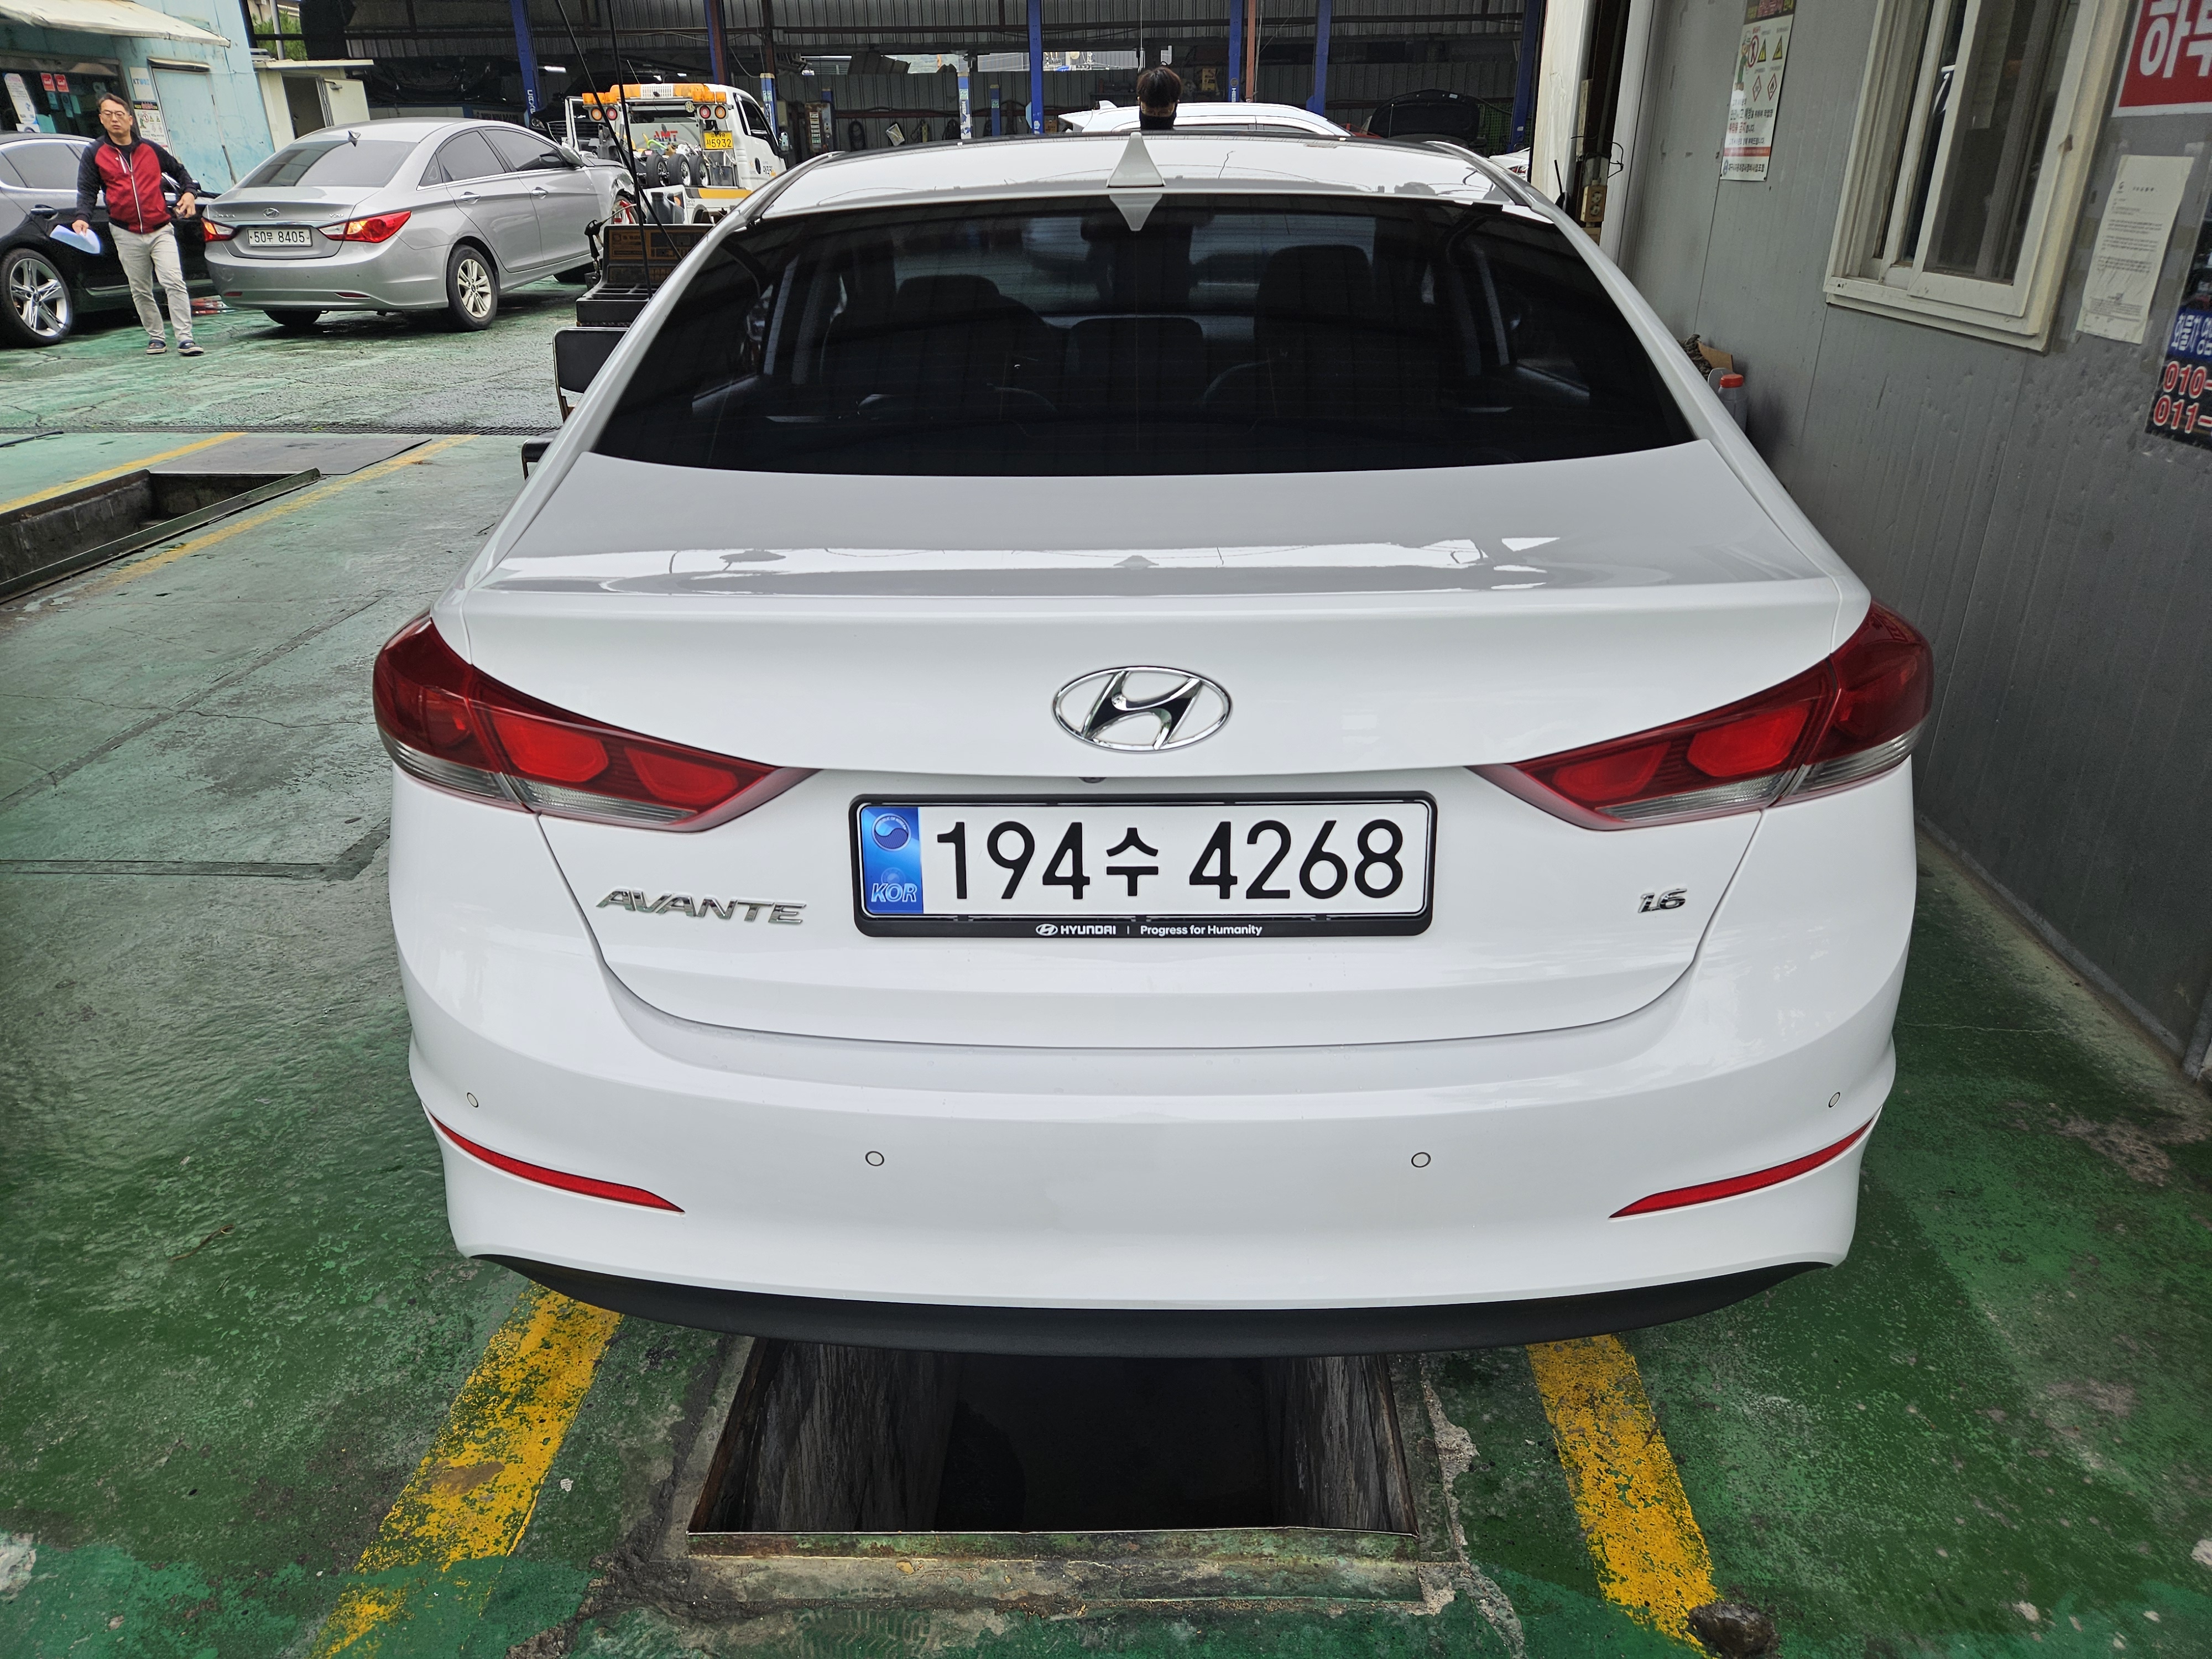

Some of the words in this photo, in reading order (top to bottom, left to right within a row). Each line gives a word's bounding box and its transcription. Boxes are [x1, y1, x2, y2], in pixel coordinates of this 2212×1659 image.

[653, 131, 678, 142] AMT
[254, 231, 273, 243] 50무
[278, 231, 305, 243] 8405
[2171, 313, 2203, 352] 화물차
[937, 820, 1159, 900] 194수
[1189, 819, 1404, 900] 4268
[871, 883, 917, 902] KOR
[596, 888, 807, 924] AVANTE
[1060, 925, 1117, 935] HYUNDAI
[1140, 925, 1188, 937] Progress
[1190, 924, 1206, 935] for
[1208, 924, 1262, 936] Humanity
